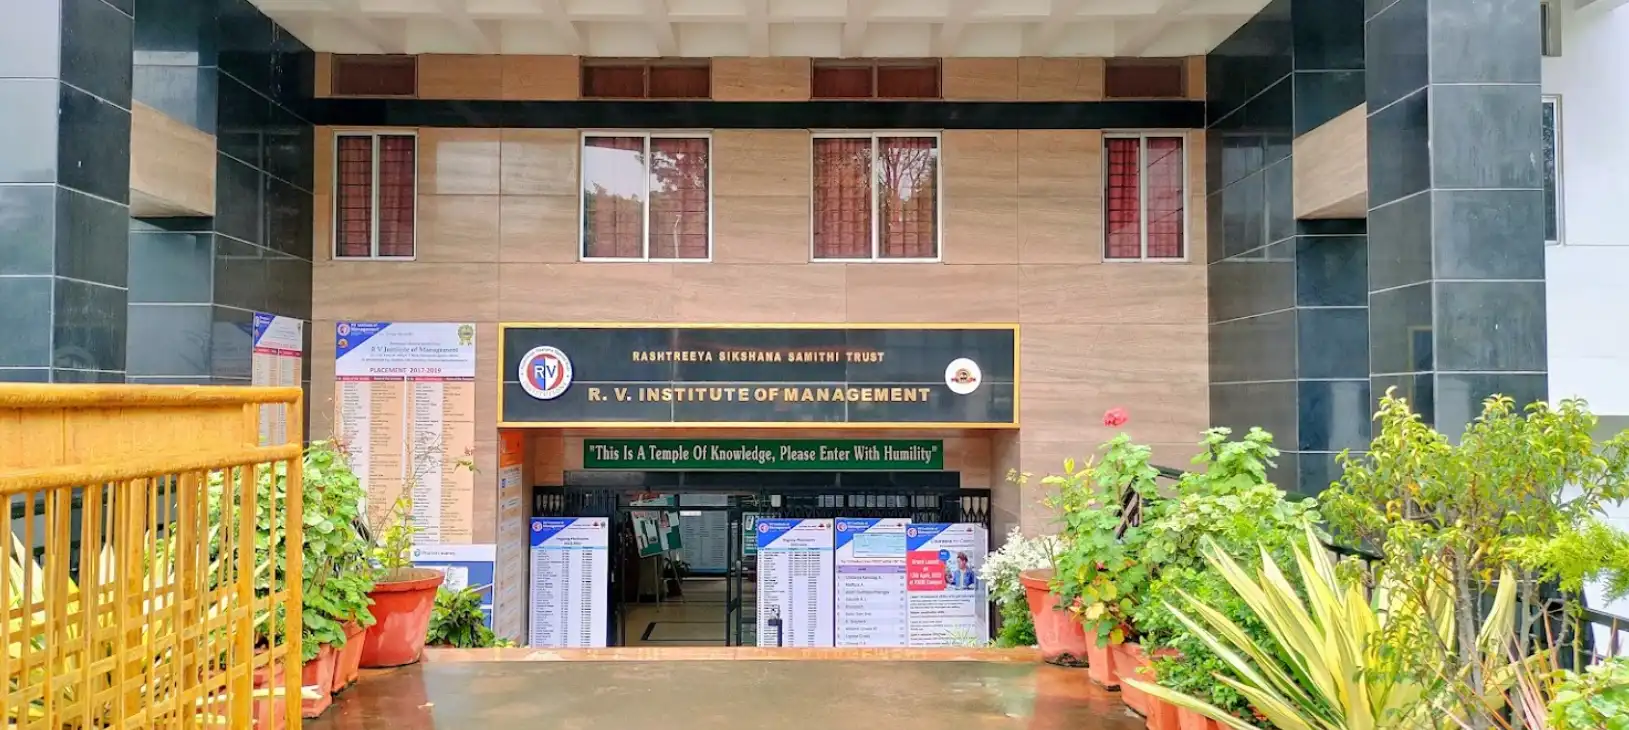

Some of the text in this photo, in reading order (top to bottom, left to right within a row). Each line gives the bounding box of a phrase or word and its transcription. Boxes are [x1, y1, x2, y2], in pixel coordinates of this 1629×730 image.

[633, 351, 885, 362] RASHTREEYA SIKSHANA SAMITHI TRUST
[588, 388, 931, 402] R. V. INSTITUTE OF MANAGEMENT
[589, 445, 938, 464] "This Is A Temple Of Knowledge, Please Enter With Humility"
